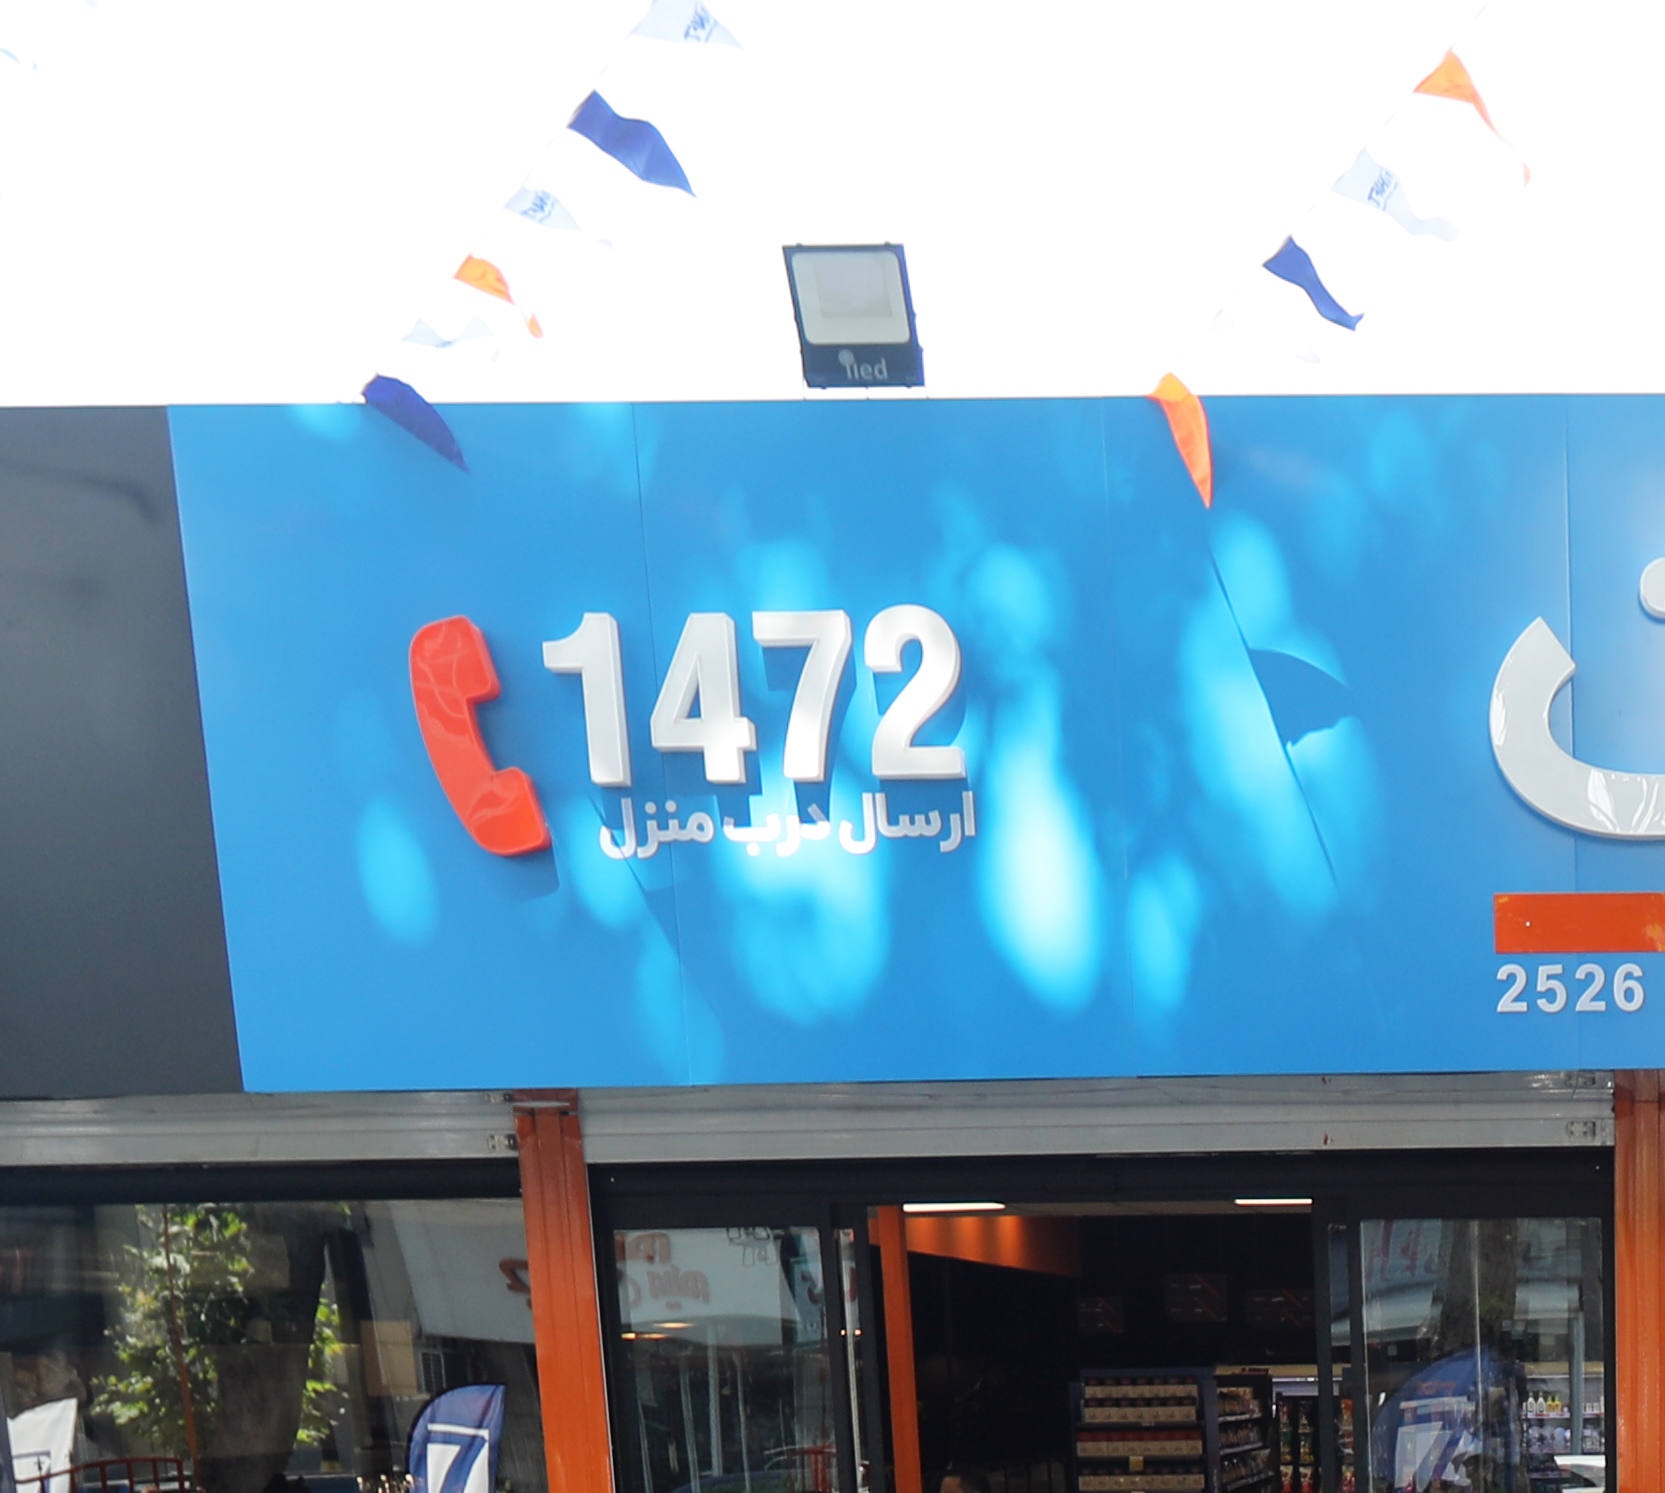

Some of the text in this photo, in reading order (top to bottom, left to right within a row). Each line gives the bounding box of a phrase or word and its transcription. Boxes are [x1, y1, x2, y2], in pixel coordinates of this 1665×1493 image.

[541, 603, 968, 788] 1472
[597, 790, 977, 858] ارسال درب منزل
[1495, 964, 1646, 1014] 2526
